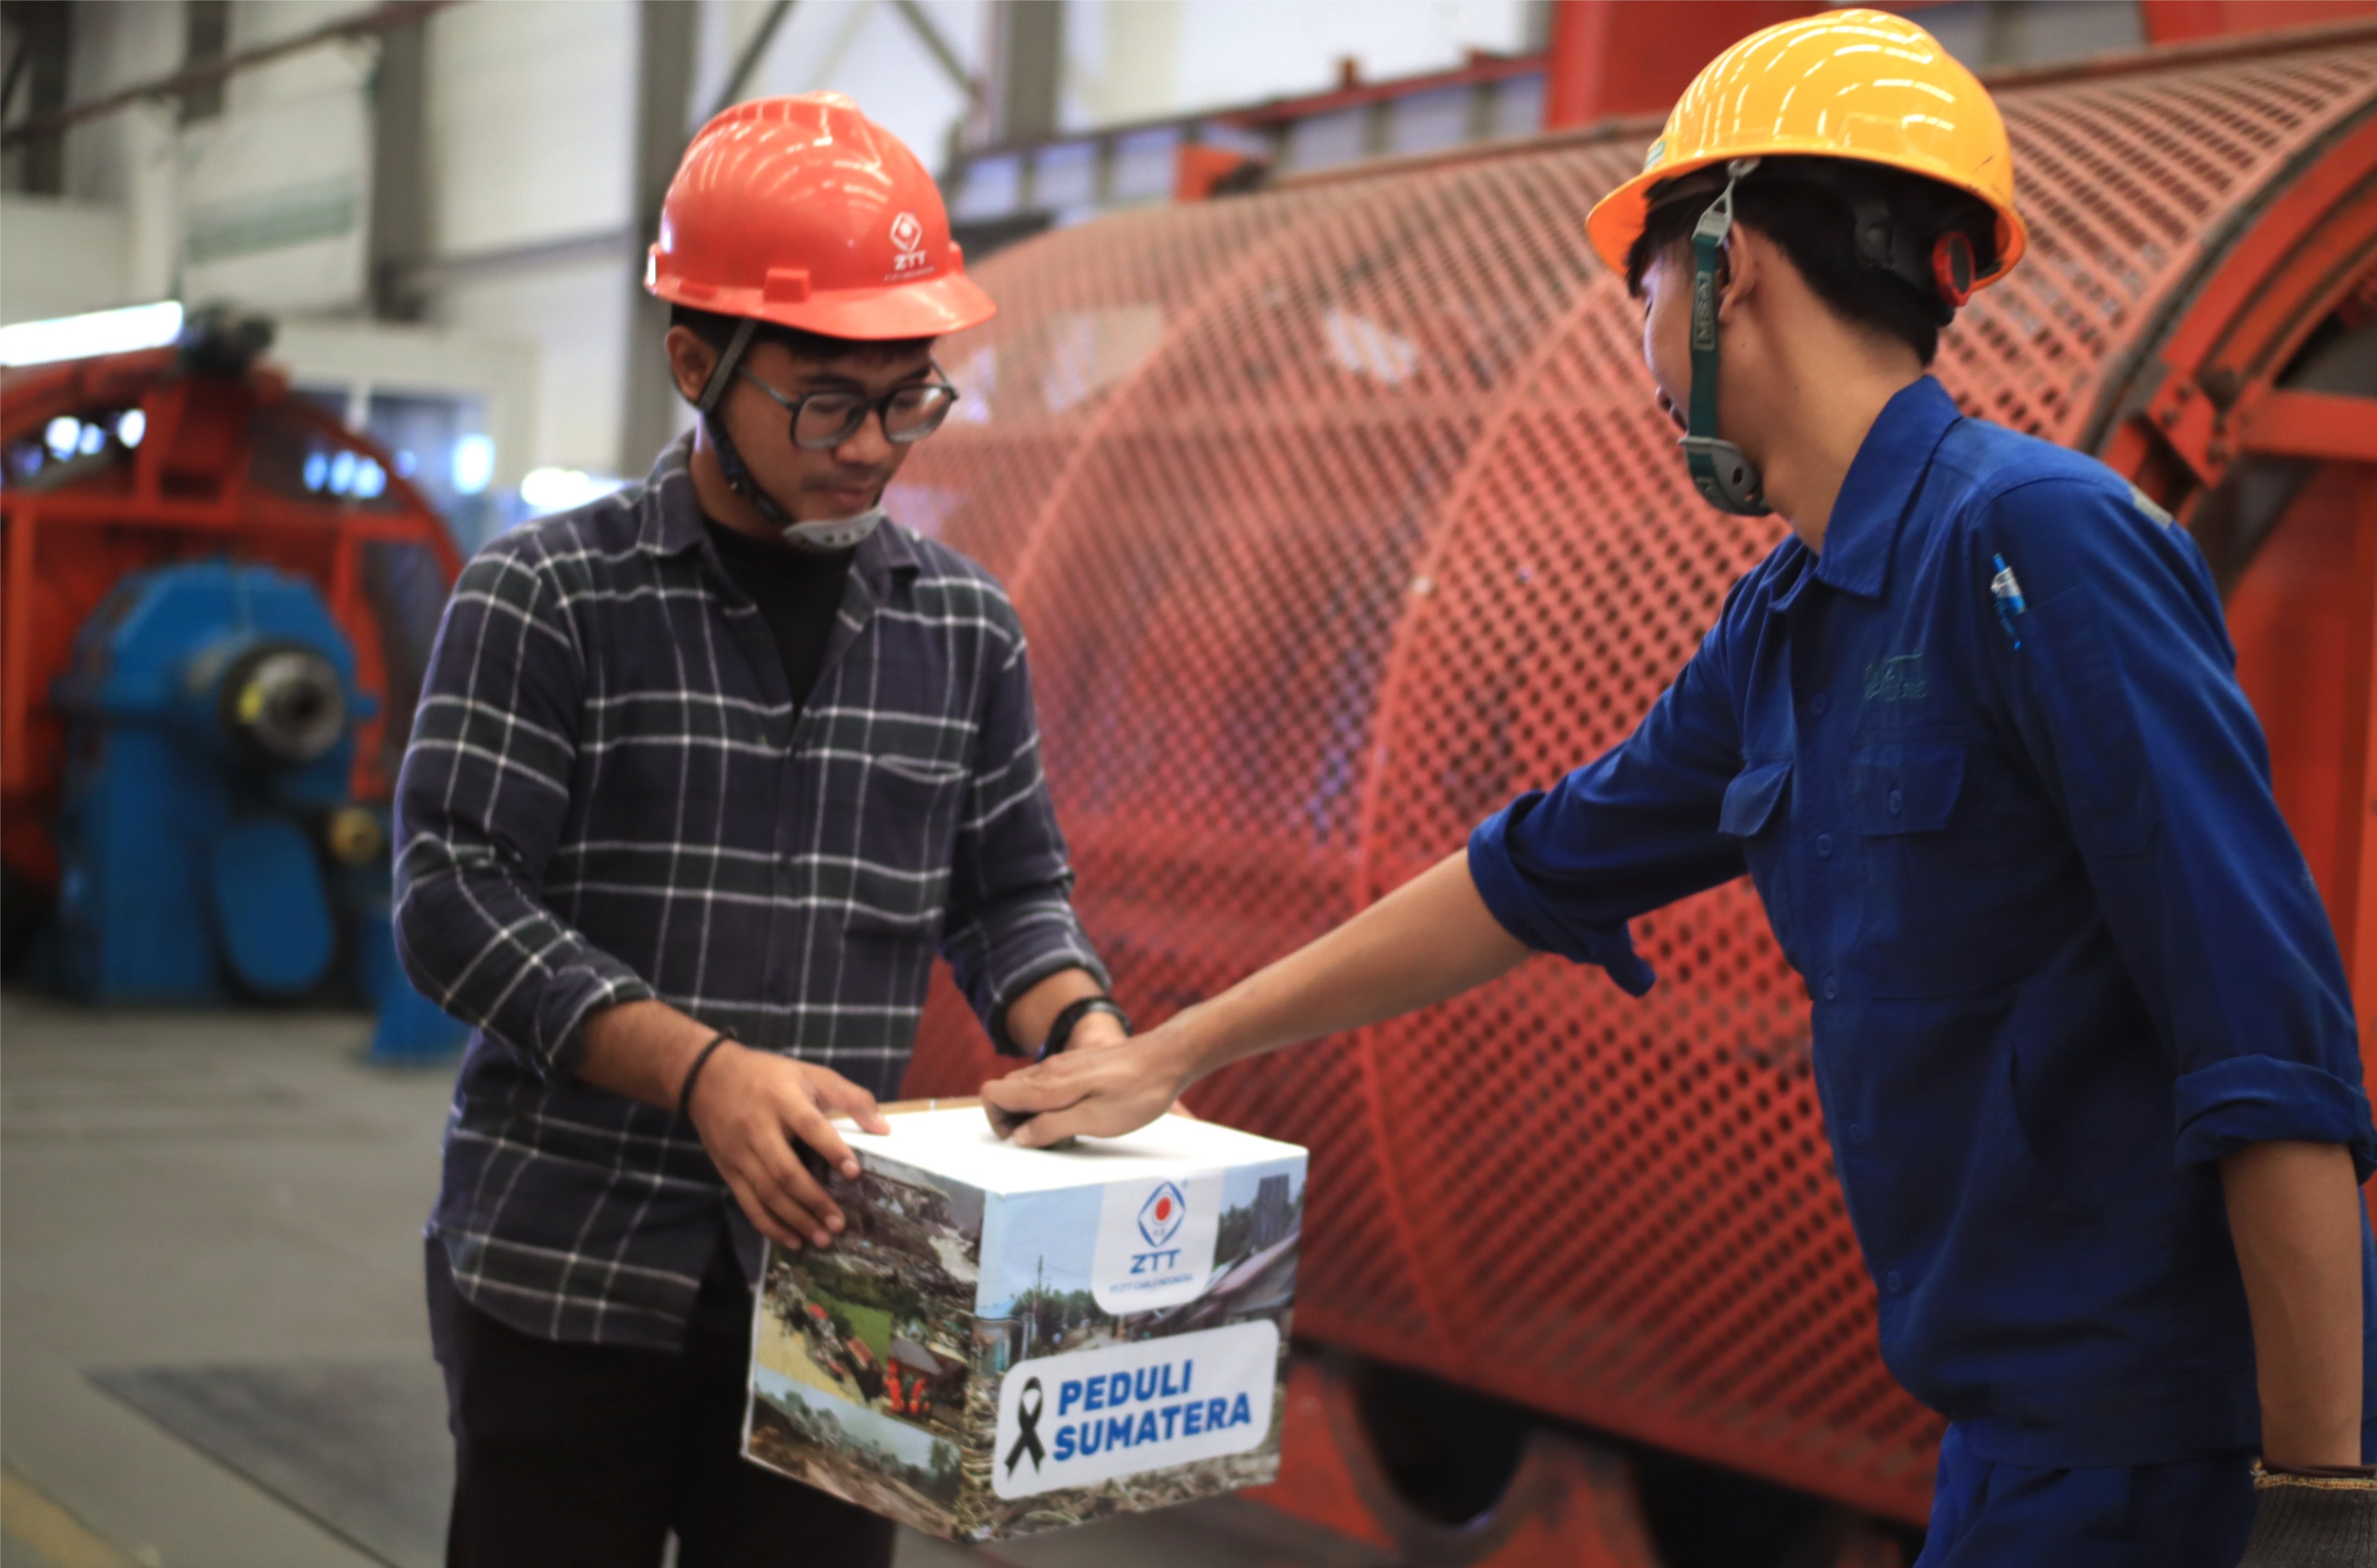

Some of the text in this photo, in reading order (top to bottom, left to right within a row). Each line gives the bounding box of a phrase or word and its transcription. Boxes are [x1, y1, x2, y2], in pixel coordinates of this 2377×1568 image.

[894, 250, 926, 270] ZTT
[1130, 1249, 1181, 1274] ZTT
[1058, 1359, 1193, 1417] PEDULI
[1053, 1392, 1251, 1461] SUMATERA
